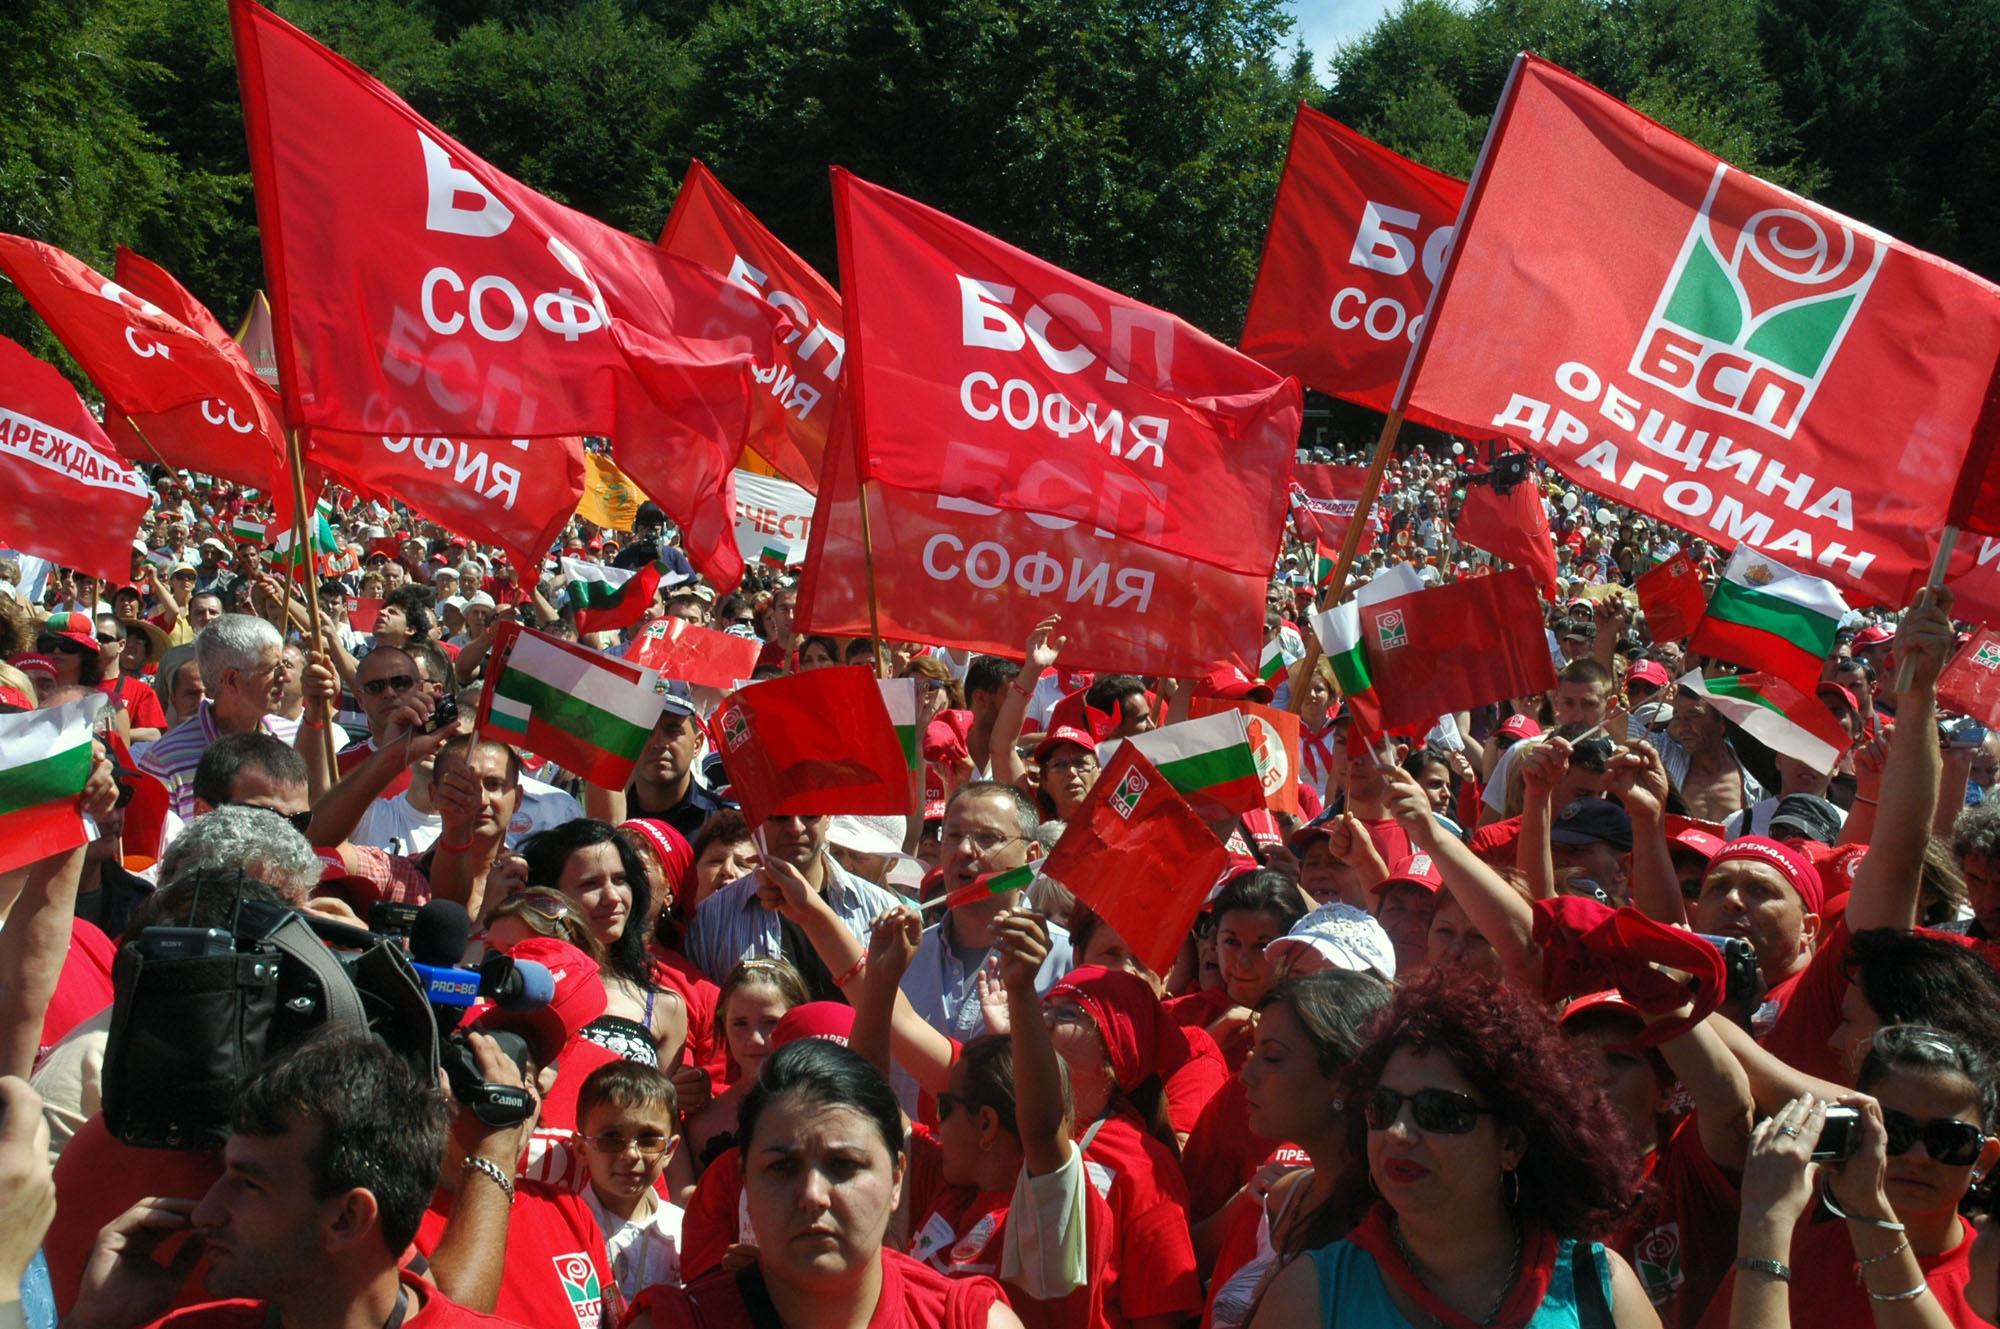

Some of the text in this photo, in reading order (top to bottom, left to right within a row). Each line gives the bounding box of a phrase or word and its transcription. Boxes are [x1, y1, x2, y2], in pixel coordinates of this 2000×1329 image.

[956, 273, 1175, 391] БСП
[1640, 327, 1806, 431] БСП
[960, 371, 1170, 468] СОФИЯ
[1554, 361, 1855, 531] ОБЩИНА
[1491, 393, 1877, 580] ДРАГОМАН
[923, 533, 1155, 613] СОФИЯ
[1383, 636, 1407, 649] БСП
[1974, 656, 1996, 668] БСП
[1110, 794, 1131, 817] БСП
[160, 940, 183, 948] SONY
[489, 1093, 523, 1108] Canon
